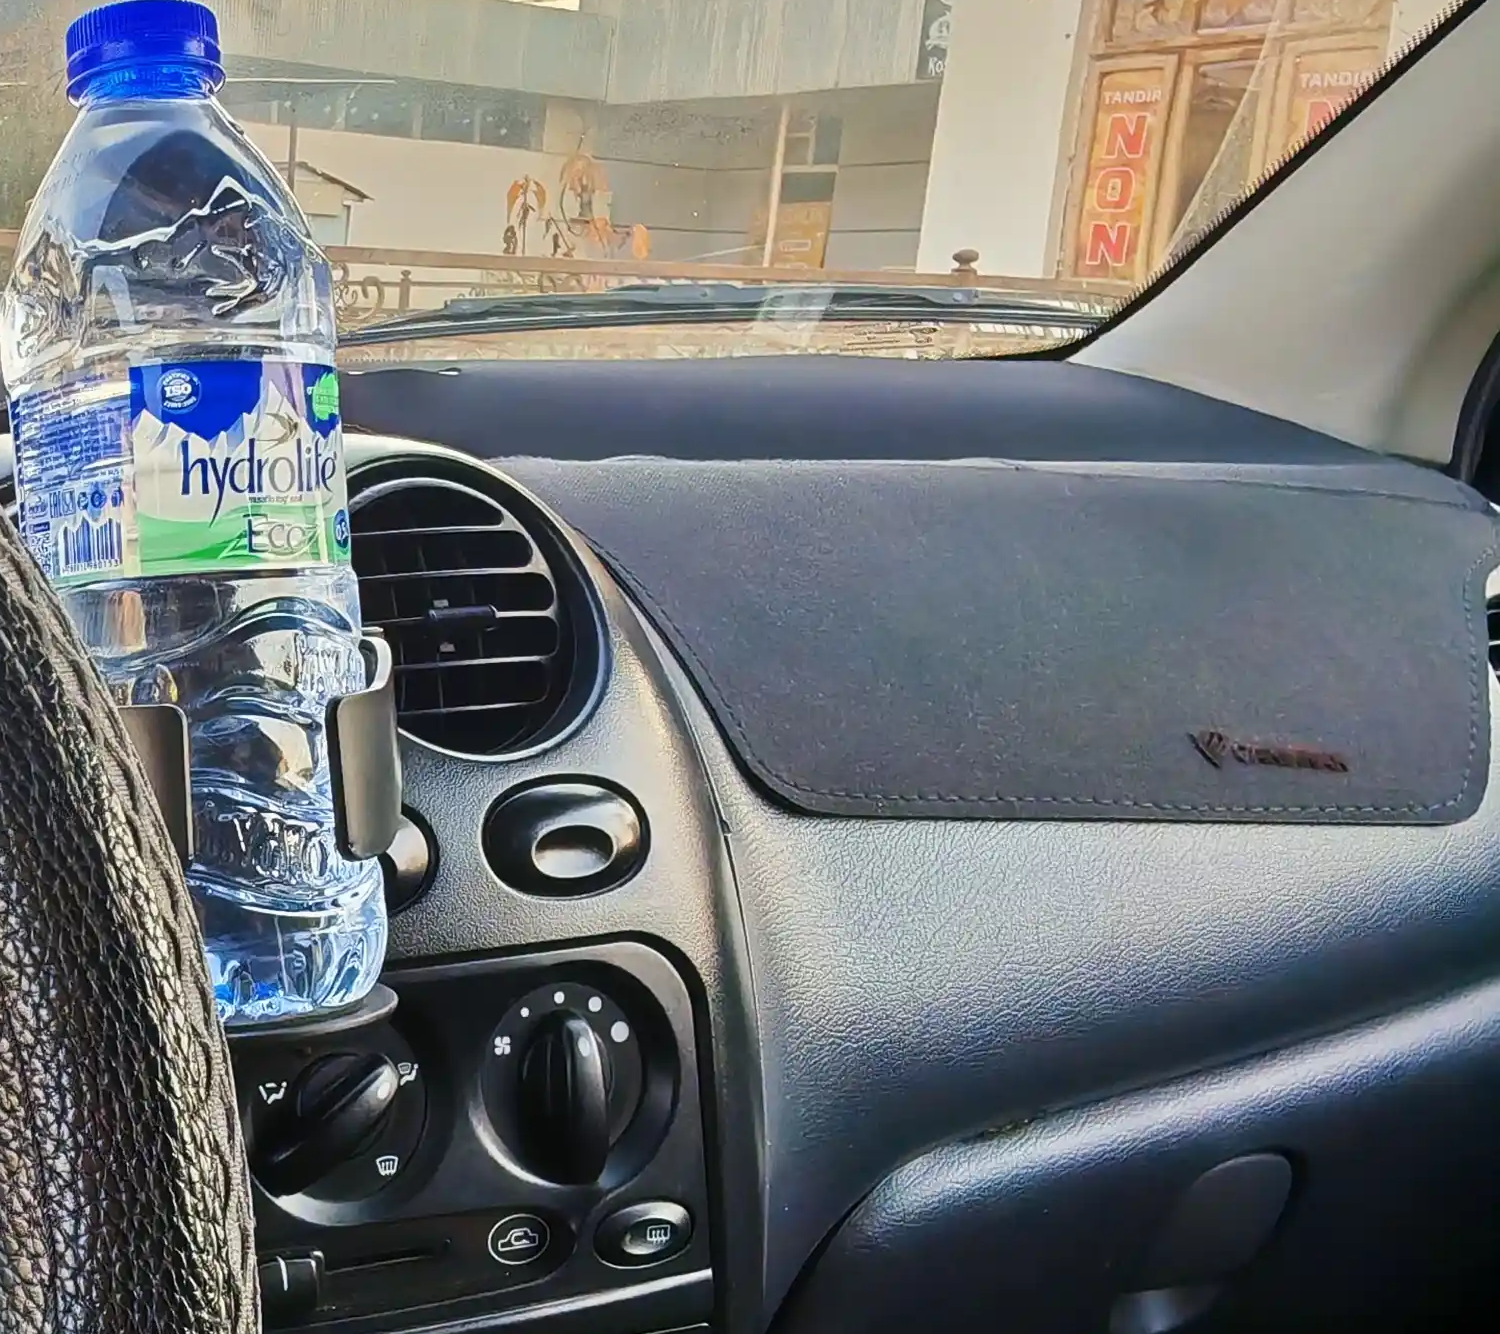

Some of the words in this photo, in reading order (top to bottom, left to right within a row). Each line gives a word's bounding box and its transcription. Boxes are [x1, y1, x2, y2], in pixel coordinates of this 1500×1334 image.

[1103, 87, 1162, 105] TANDIR
[1085, 113, 1151, 267] NON
[180, 437, 338, 528] hydrolife
